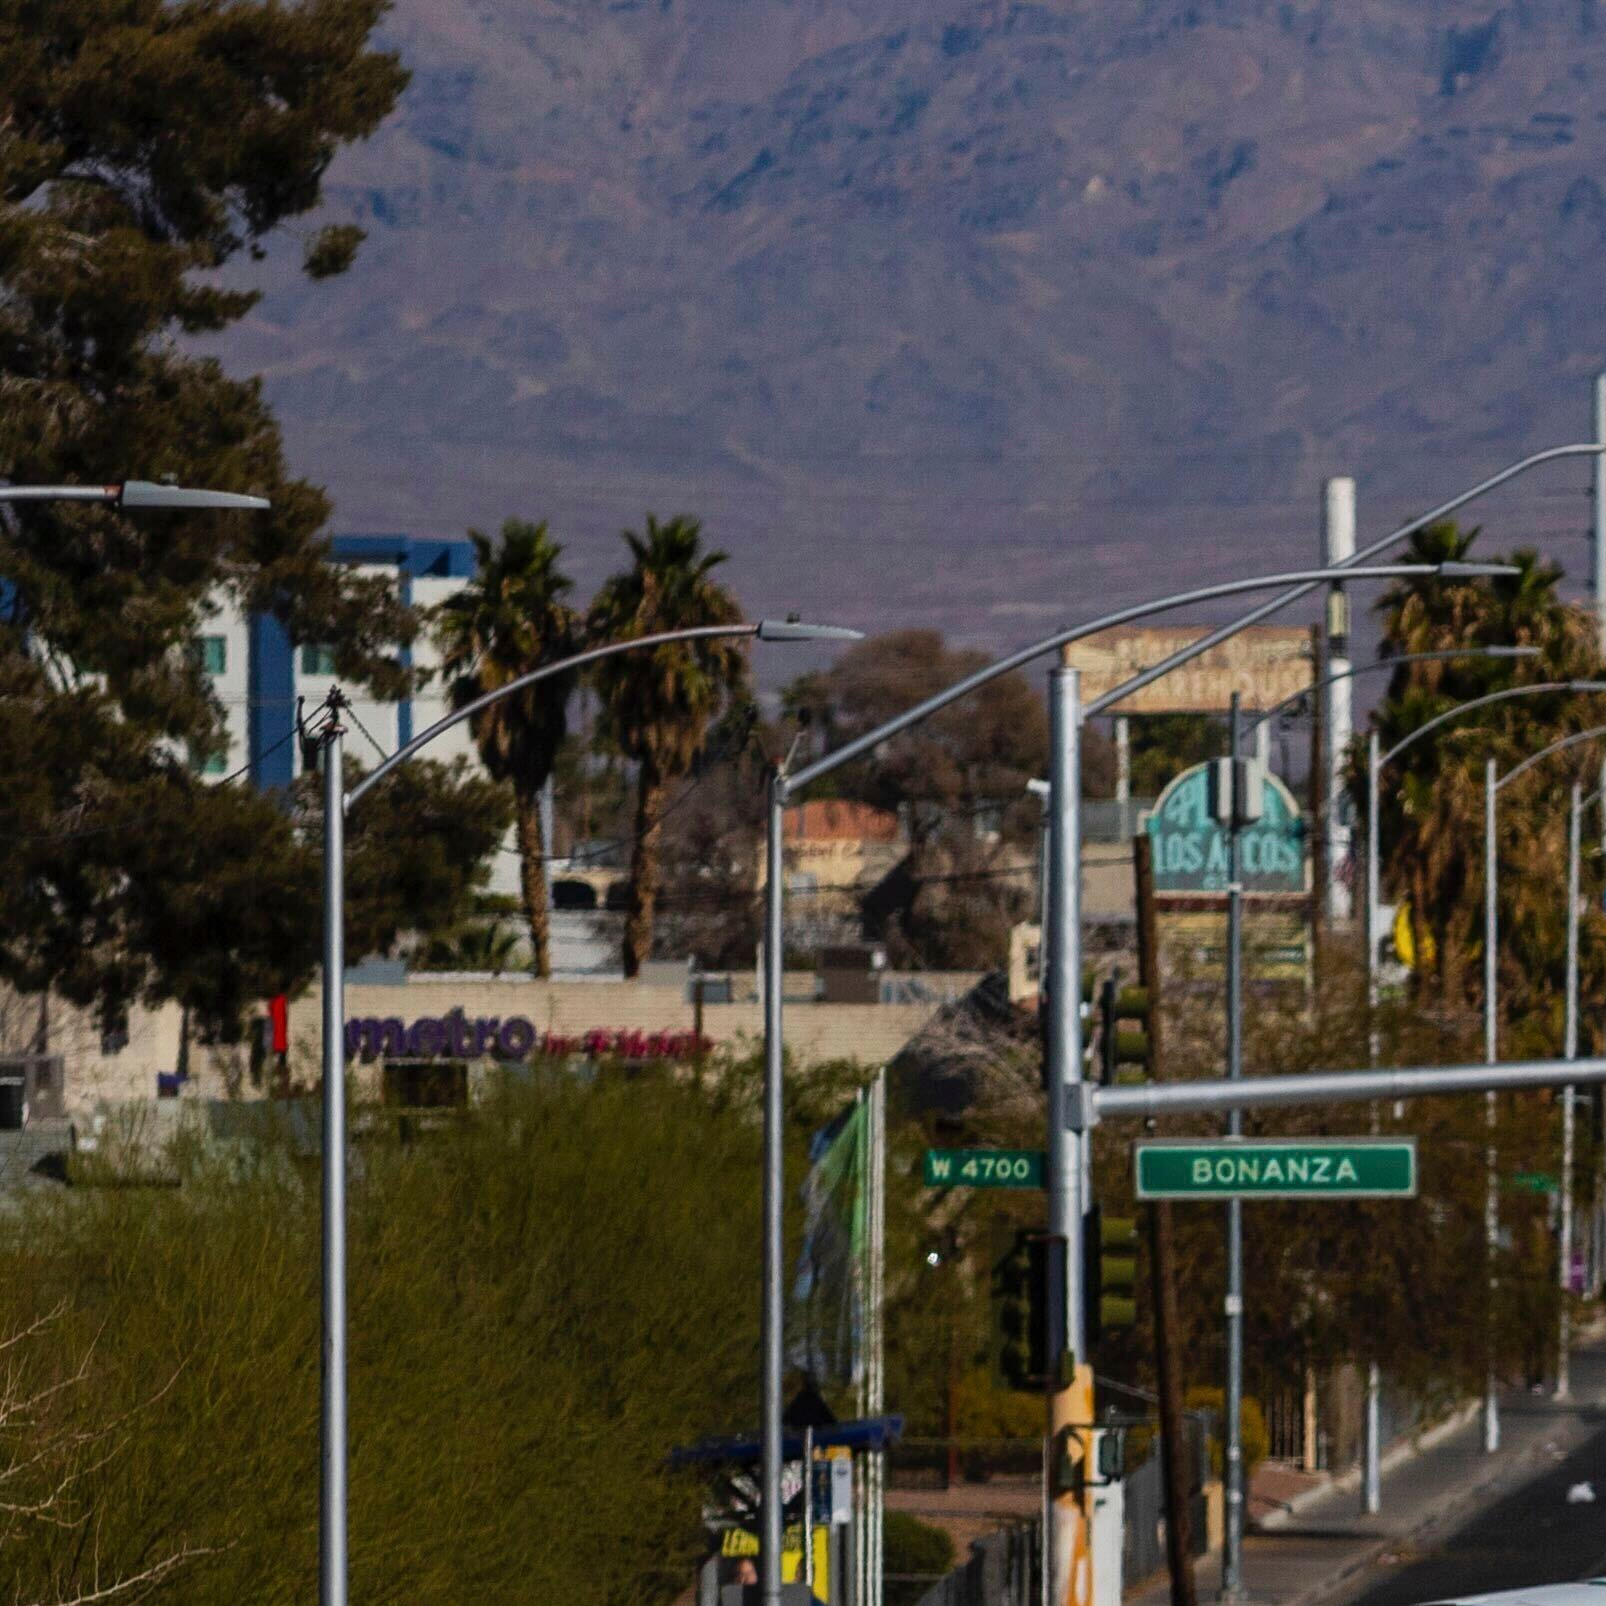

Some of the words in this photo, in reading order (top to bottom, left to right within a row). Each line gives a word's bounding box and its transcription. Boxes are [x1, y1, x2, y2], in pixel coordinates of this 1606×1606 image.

[1206, 830, 1301, 875] ACOS
[343, 1004, 537, 1064] metro
[931, 1157, 951, 1178] W
[961, 1157, 1031, 1179] 4700
[1191, 1157, 1359, 1185] BONANZA
